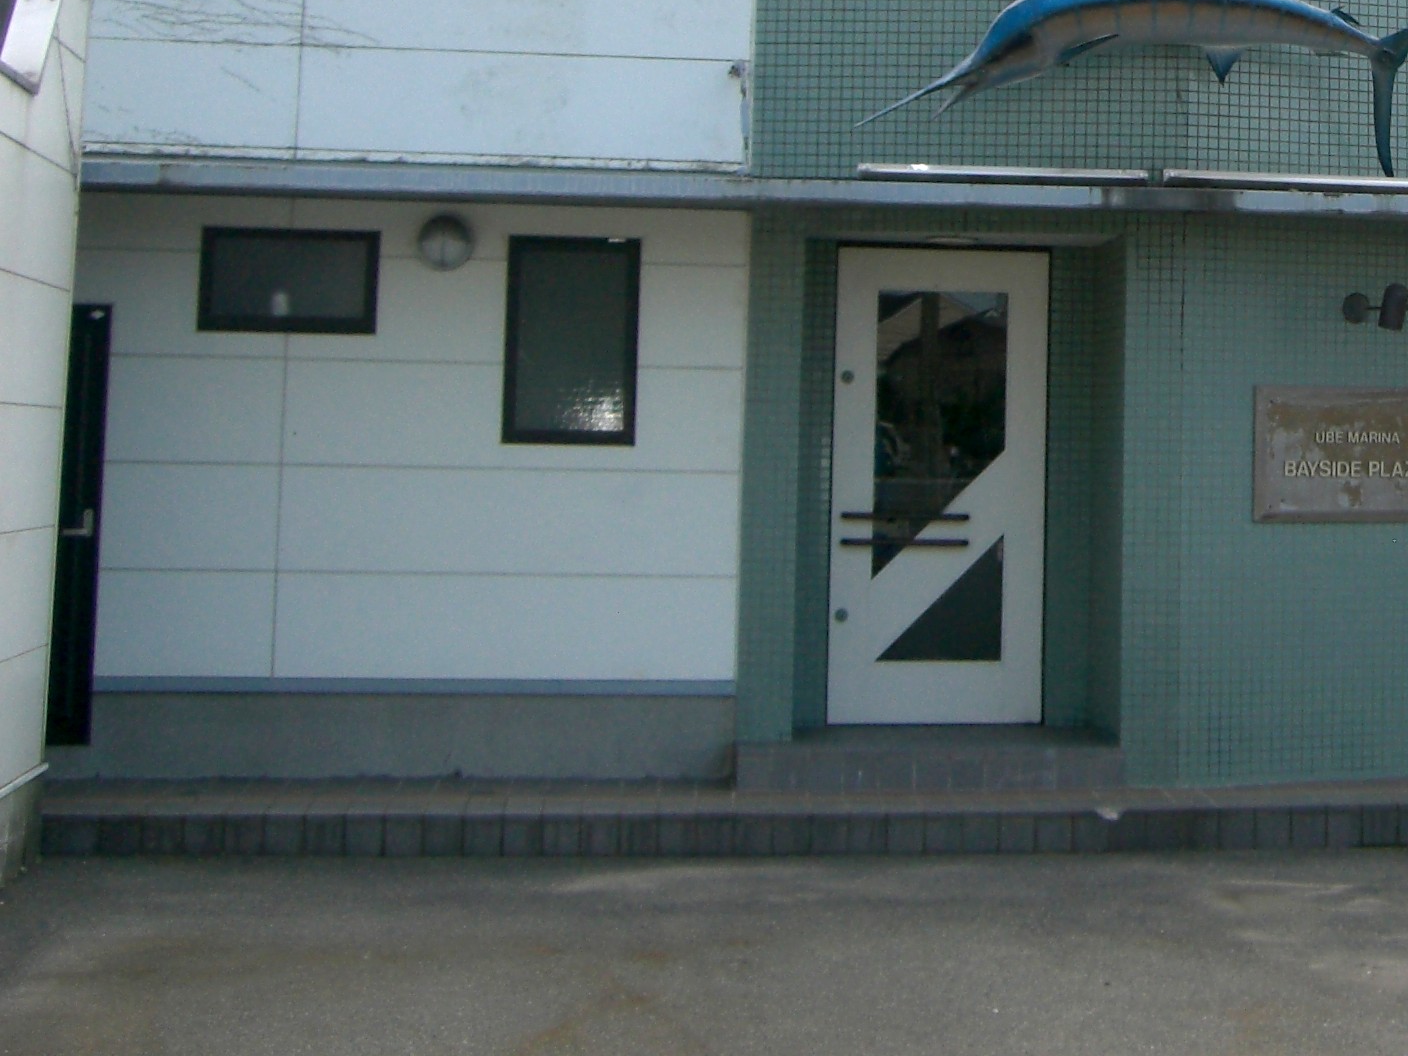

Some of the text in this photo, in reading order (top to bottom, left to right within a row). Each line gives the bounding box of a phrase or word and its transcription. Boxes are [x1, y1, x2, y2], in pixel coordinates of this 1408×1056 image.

[1315, 431, 1400, 444] UBE MARINA
[1284, 460, 1362, 477] BAYSIDE
